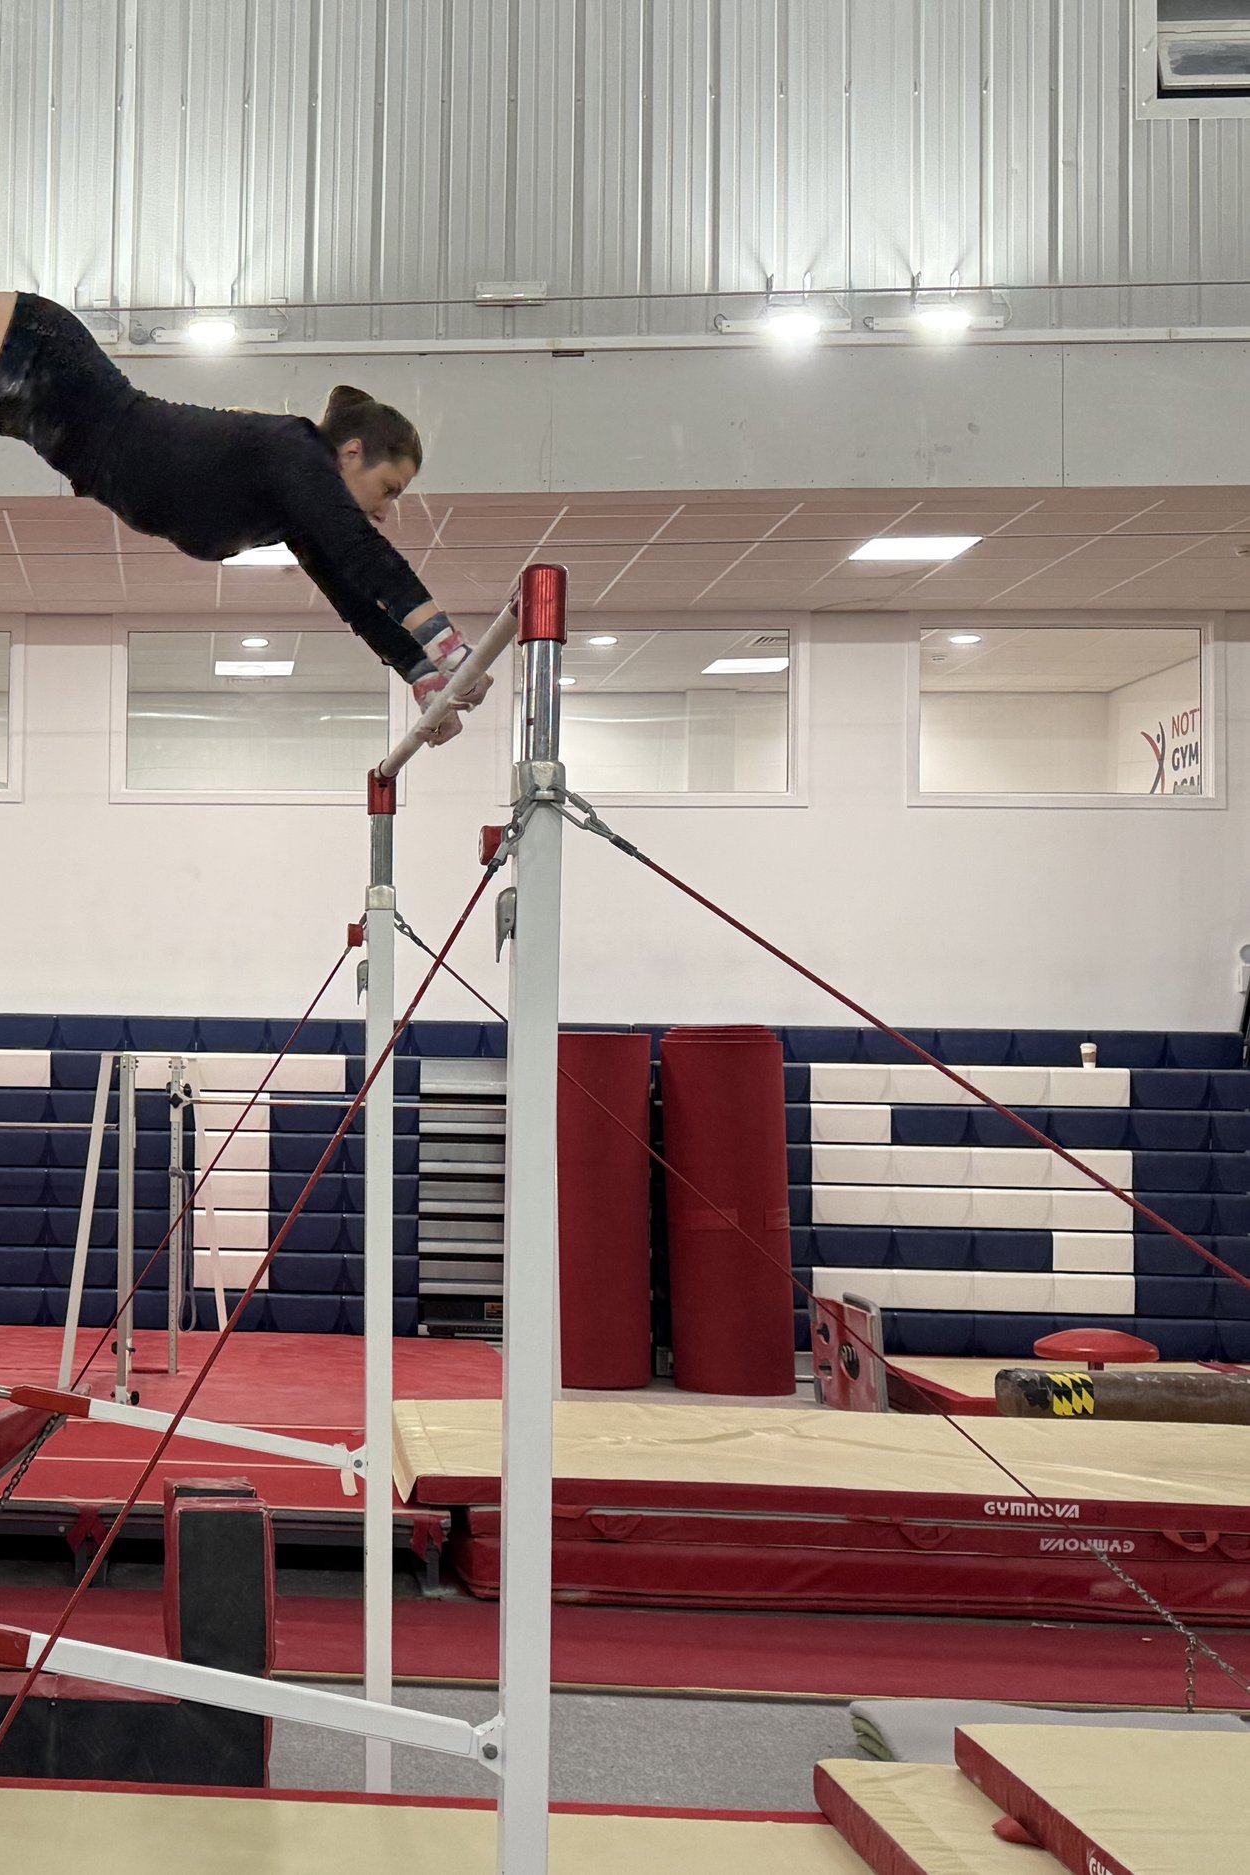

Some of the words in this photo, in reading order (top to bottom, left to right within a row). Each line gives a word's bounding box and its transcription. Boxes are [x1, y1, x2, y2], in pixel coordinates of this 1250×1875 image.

[1172, 707, 1200, 739] NOT
[984, 1501, 1080, 1519] GYMNOVA
[1039, 1538, 1135, 1553] GYMNOVA
